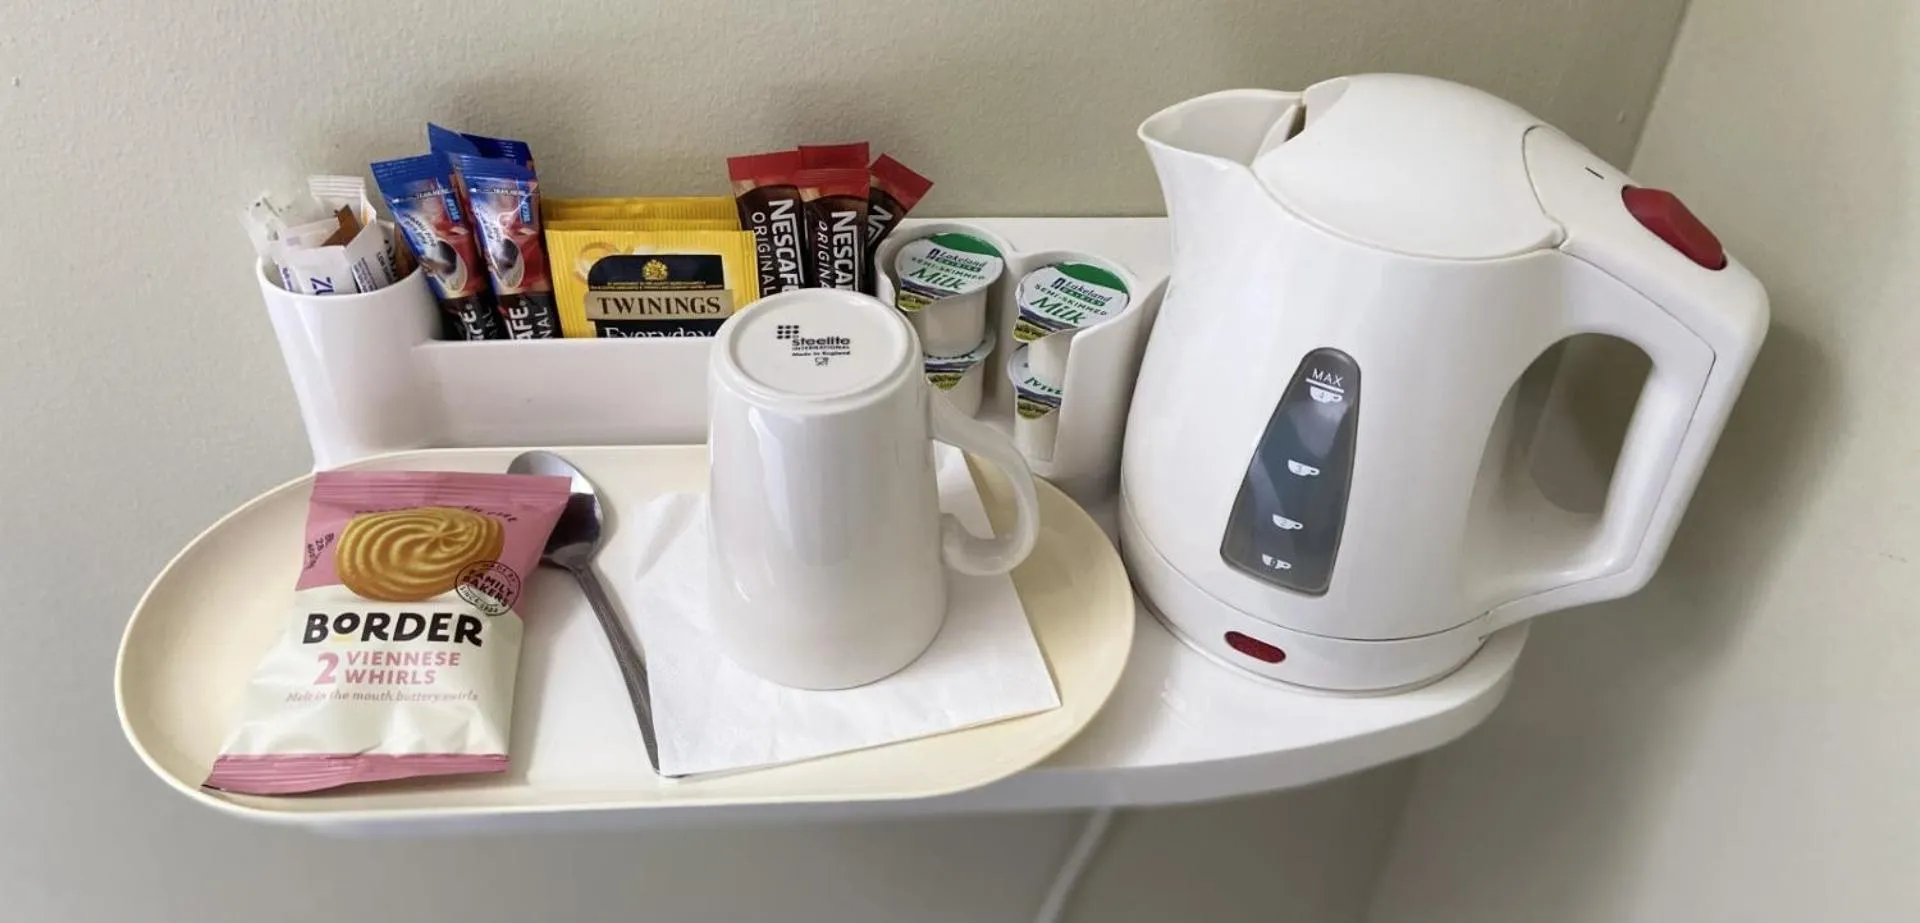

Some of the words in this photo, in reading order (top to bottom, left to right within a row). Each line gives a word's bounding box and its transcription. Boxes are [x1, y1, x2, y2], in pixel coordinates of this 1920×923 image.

[752, 211, 776, 296] ORIGINAL
[817, 220, 832, 288] ORIGINA
[831, 211, 857, 291] NESCA
[909, 267, 967, 289] Milk
[1065, 281, 1113, 302] Lakeland
[597, 296, 721, 315] TWININGS
[1029, 296, 1086, 324] Milk
[792, 337, 850, 346] steelite
[1312, 367, 1344, 388] MAX
[303, 612, 483, 647] BORDER
[313, 652, 339, 685] 2
[346, 651, 461, 667] VIENNESE
[345, 669, 437, 685] WHIRLS
[353, 689, 393, 701] mouth
